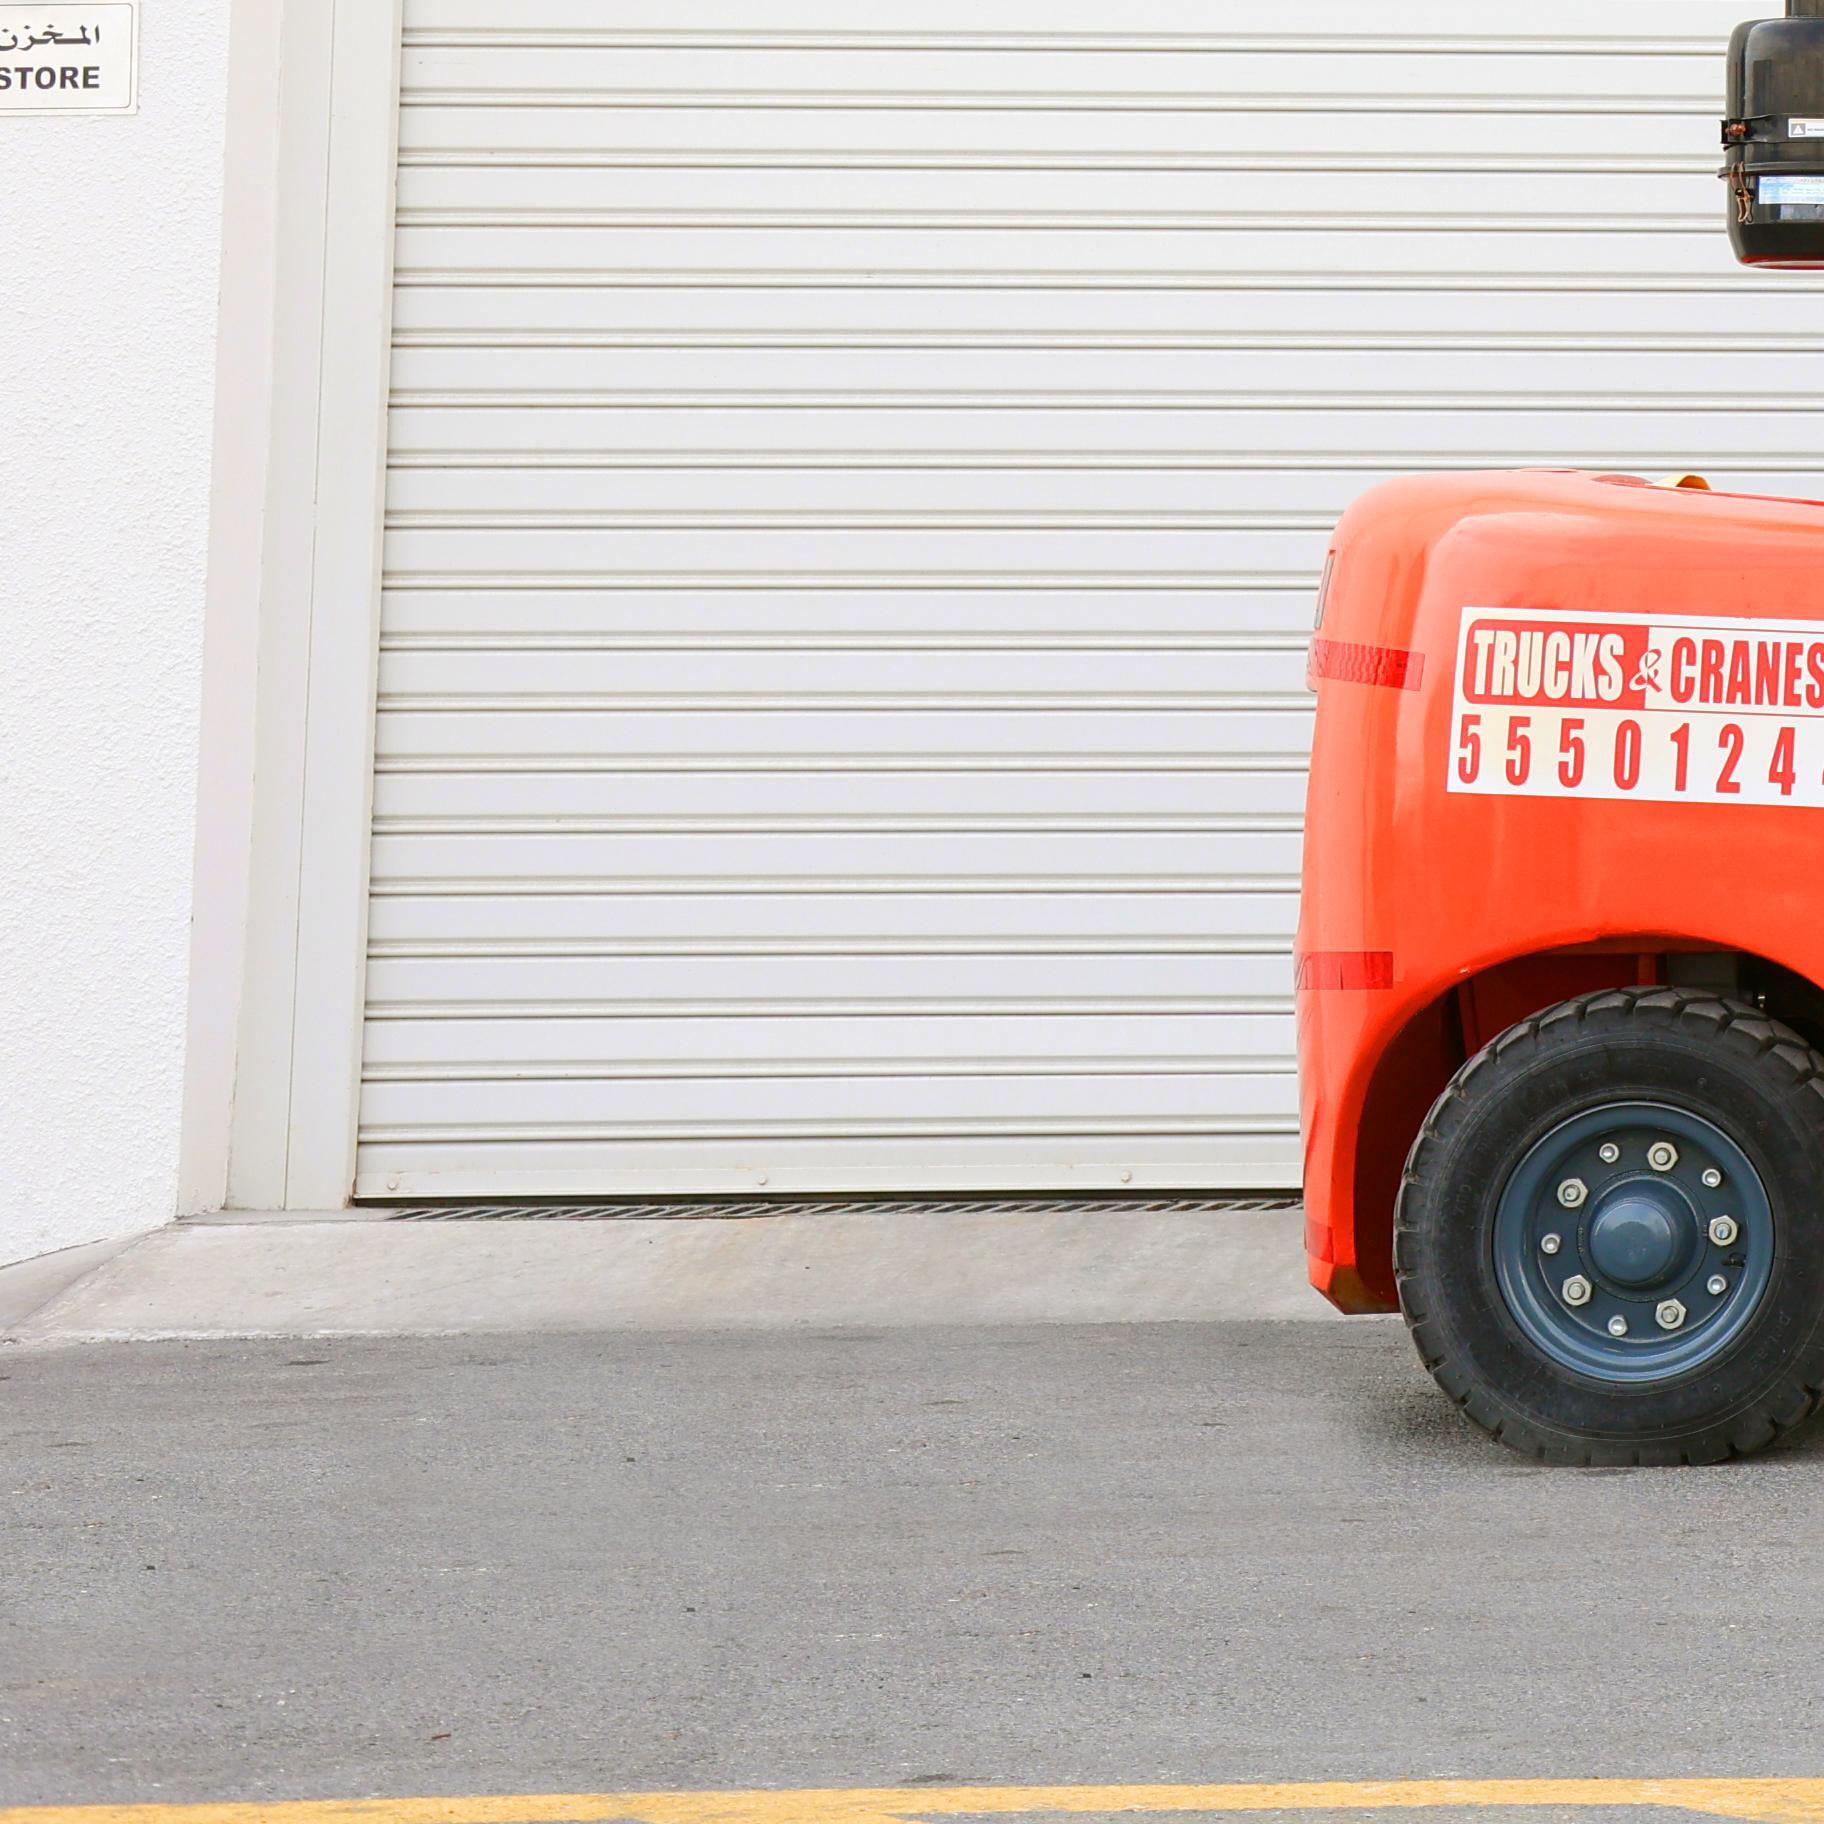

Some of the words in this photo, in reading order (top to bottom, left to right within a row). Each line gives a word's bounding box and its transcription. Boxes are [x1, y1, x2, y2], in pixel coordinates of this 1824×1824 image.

[0, 24, 100, 52] المخزن
[0, 66, 100, 90] STORE
[1472, 628, 1625, 702] TRUCKS
[1628, 647, 1662, 693] &
